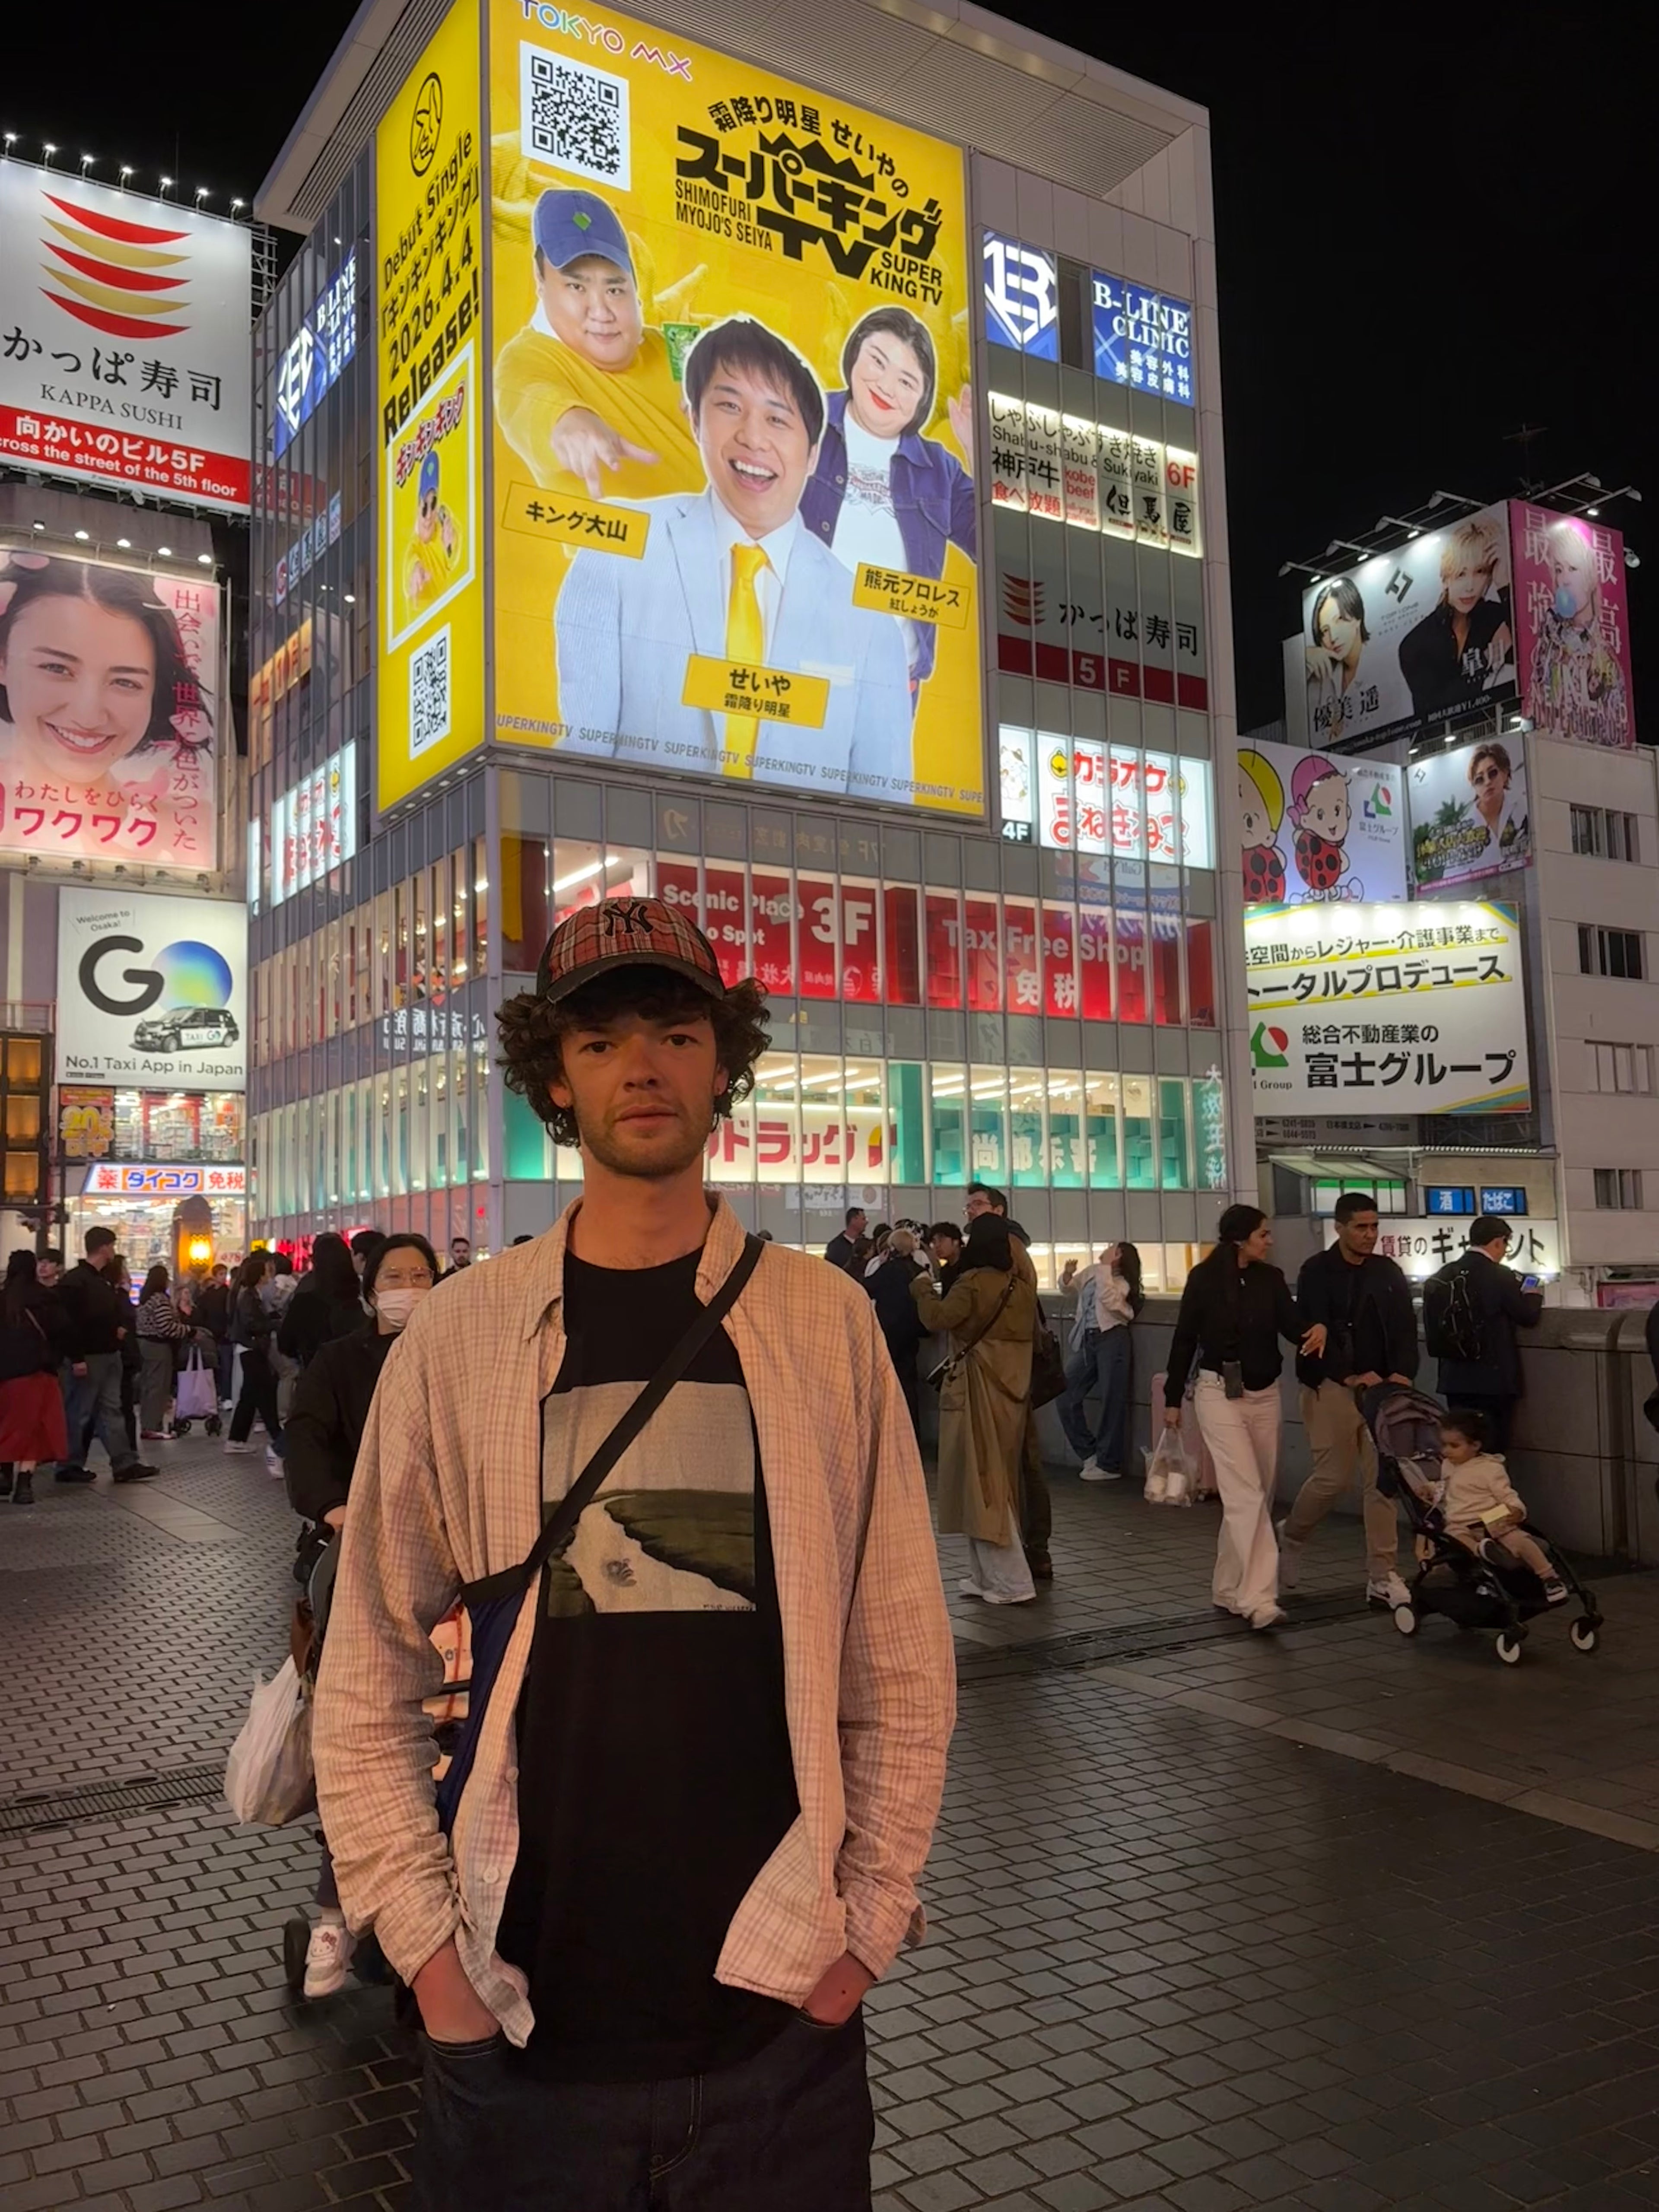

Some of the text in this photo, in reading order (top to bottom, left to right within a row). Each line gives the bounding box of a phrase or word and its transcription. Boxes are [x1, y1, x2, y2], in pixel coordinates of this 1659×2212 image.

[524, 0, 693, 81] TOKYO MX
[708, 95, 909, 198] 霜降り明星 せいやの
[384, 130, 472, 287] Debut Single
[676, 125, 942, 261] スーパーキング
[676, 180, 751, 221] SHIMOFURI
[676, 202, 772, 251] MYOJO'S SEIYA
[756, 206, 877, 280] TV
[871, 268, 942, 305] KING TV
[881, 251, 942, 286] SUPER
[390, 223, 473, 382] 2026.4.4
[1093, 280, 1188, 336] B-LINE
[1113, 316, 1189, 358] CLINIC
[3, 326, 222, 411] かっぱ寿司
[384, 268, 478, 446] Release!
[41, 384, 183, 431] KAPPA SUSHI
[16, 415, 205, 470] 向かいのビル5F
[44, 444, 70, 461] the
[74, 452, 121, 473] street
[125, 462, 142, 477] of
[145, 465, 169, 482] the
[174, 470, 197, 488] 5th
[202, 477, 236, 497] floor
[992, 446, 1060, 488] 神戸牛
[1065, 469, 1095, 486] kobe
[1167, 462, 1195, 488] 6F
[1066, 481, 1094, 500] beef
[526, 502, 628, 541] キング大山
[864, 569, 960, 607] 熊元プロレス
[1592, 529, 1621, 654] 最高
[890, 598, 939, 618] 紅しょうが
[729, 669, 791, 696] せいや
[724, 694, 791, 718] 霜降り明星
[664, 742, 739, 766] SUPERKINGTV
[745, 754, 816, 777] SUPERKINGTV
[821, 766, 888, 788] SUPERKINGTV
[891, 777, 955, 798] SUPERKINGTV
[1074, 752, 1166, 793] カラオケ
[15, 780, 158, 813] わたしをひらく
[15, 807, 157, 847] ワクワク
[1002, 822, 1028, 840] 4F
[76, 912, 118, 925] Welcome
[663, 884, 804, 920] Scenic Place
[811, 897, 871, 945] 3F
[90, 921, 121, 932] Osaka!
[722, 925, 765, 946] Spot
[942, 919, 1145, 971] Tax Free Shop
[1303, 1025, 1438, 1044] 総合不動産業の
[66, 1055, 243, 1077] No.1 Taxi App in Japan
[1261, 1081, 1292, 1089] Group
[1305, 1050, 1516, 1088] 富士グループ
[128, 1170, 199, 1188] ダイコク
[209, 1171, 244, 1189] 免税
[1440, 1191, 1452, 1211] 酒
[1483, 1192, 1512, 1210] たばこ
